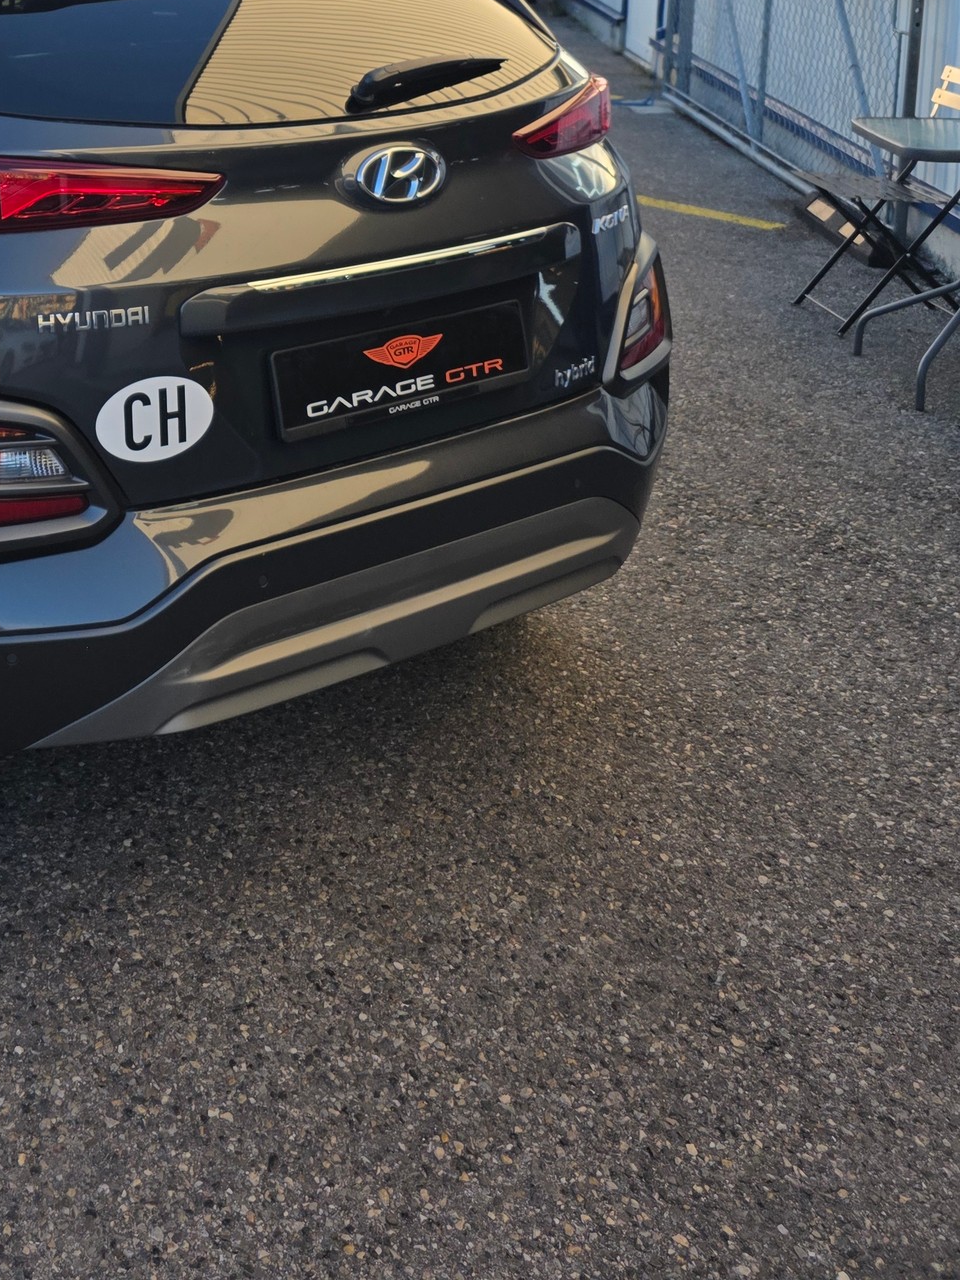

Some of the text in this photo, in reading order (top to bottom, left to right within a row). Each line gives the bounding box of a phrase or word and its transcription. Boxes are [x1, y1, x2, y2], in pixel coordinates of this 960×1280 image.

[37, 305, 150, 334] HYUNDAI
[393, 346, 414, 357] GTR
[554, 355, 595, 388] hybrid
[306, 358, 504, 418] GARAGE GTR
[123, 384, 187, 452] CH
[388, 396, 440, 414] GARAGE GTR
